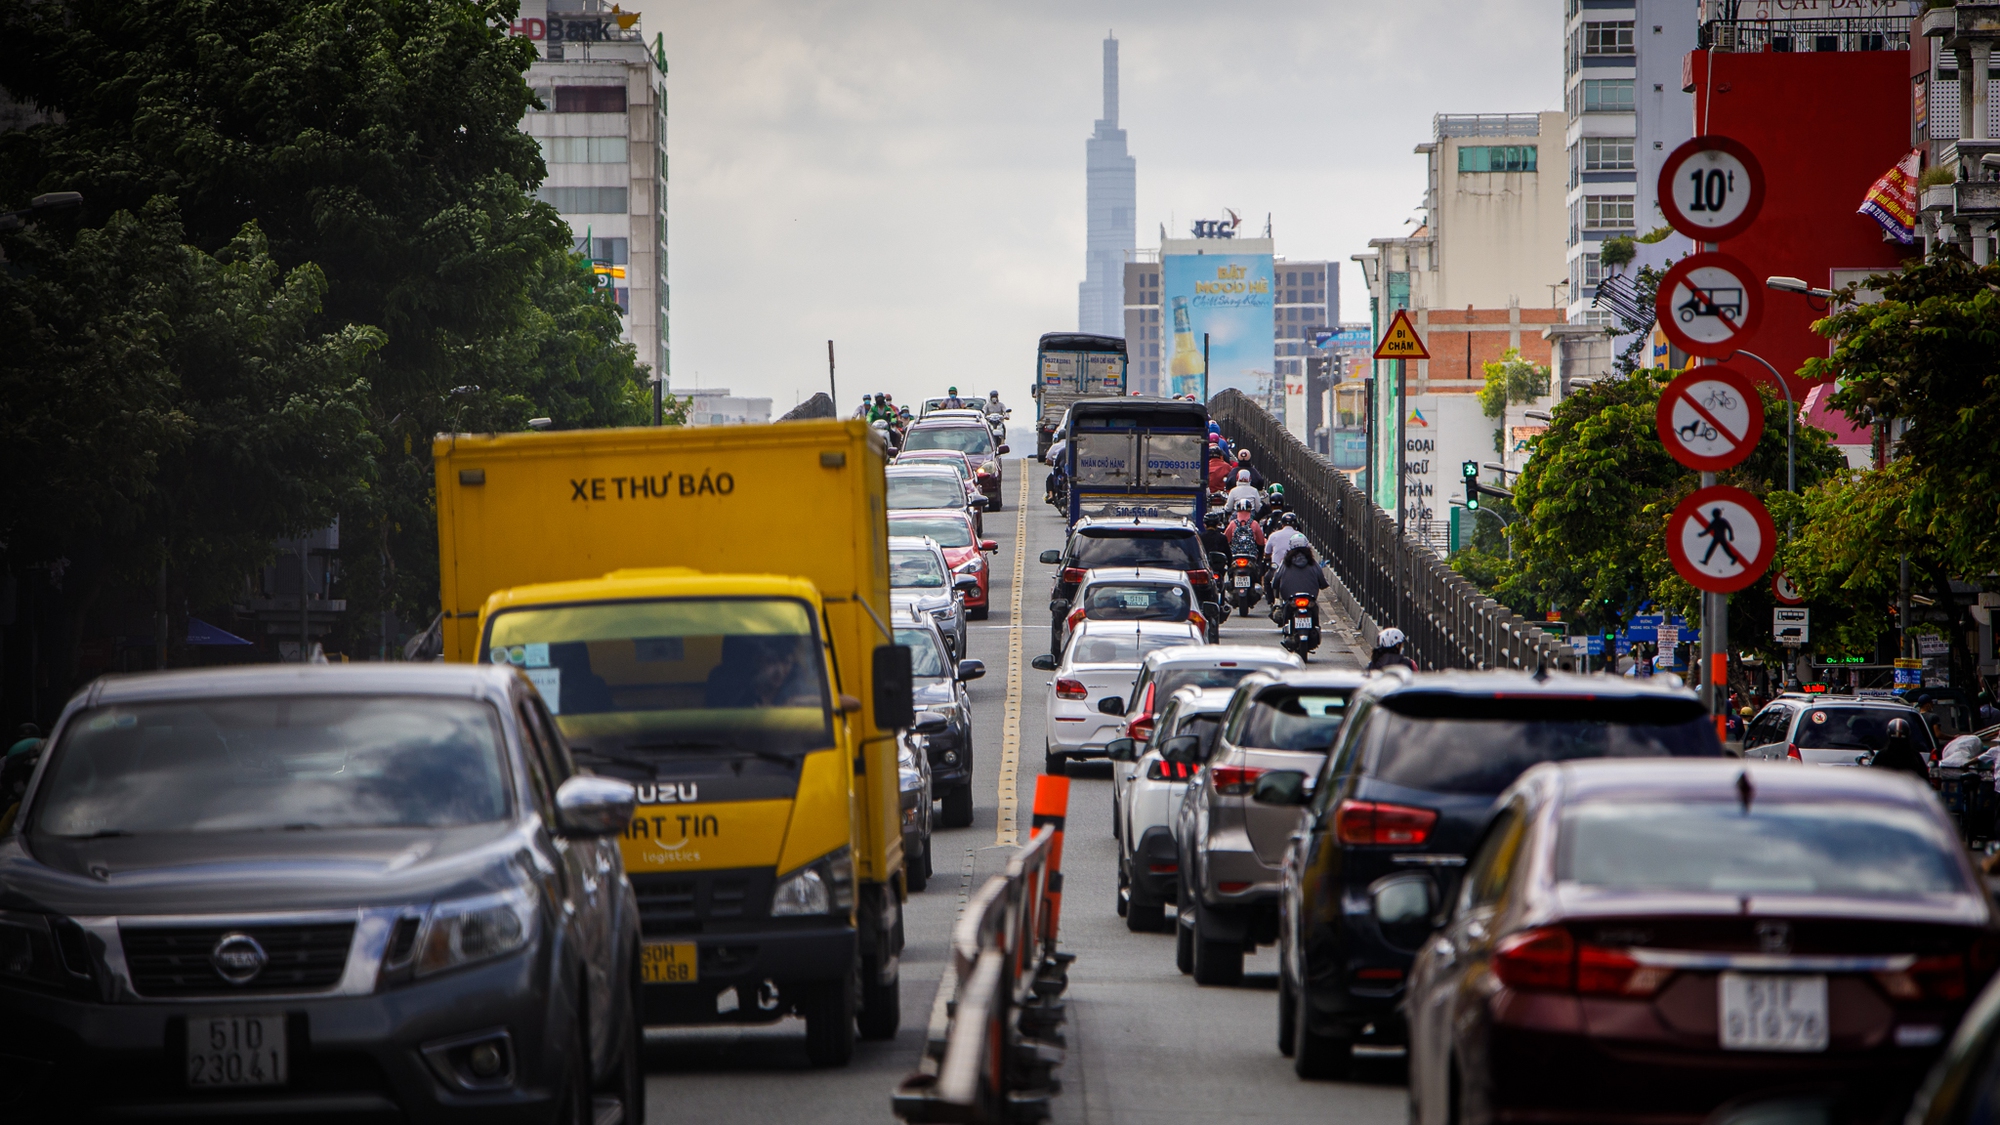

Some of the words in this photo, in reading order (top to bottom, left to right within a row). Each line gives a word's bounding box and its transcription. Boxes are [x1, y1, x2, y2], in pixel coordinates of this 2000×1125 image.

[509, 17, 611, 41] HDBank
[1195, 281, 1246, 294] MOOD
[1248, 276, 1269, 294] HÈ
[1397, 329, 1406, 339] ĐI
[1388, 340, 1414, 353] CHẬM
[1406, 439, 1435, 455] GOẠI
[1148, 460, 1201, 470] 0979693135
[570, 477, 606, 502] XE
[611, 471, 673, 500] THƯ
[678, 467, 735, 497] BÁO
[637, 781, 699, 804] UZU
[642, 850, 702, 865] logistics
[209, 1018, 264, 1051] 51D
